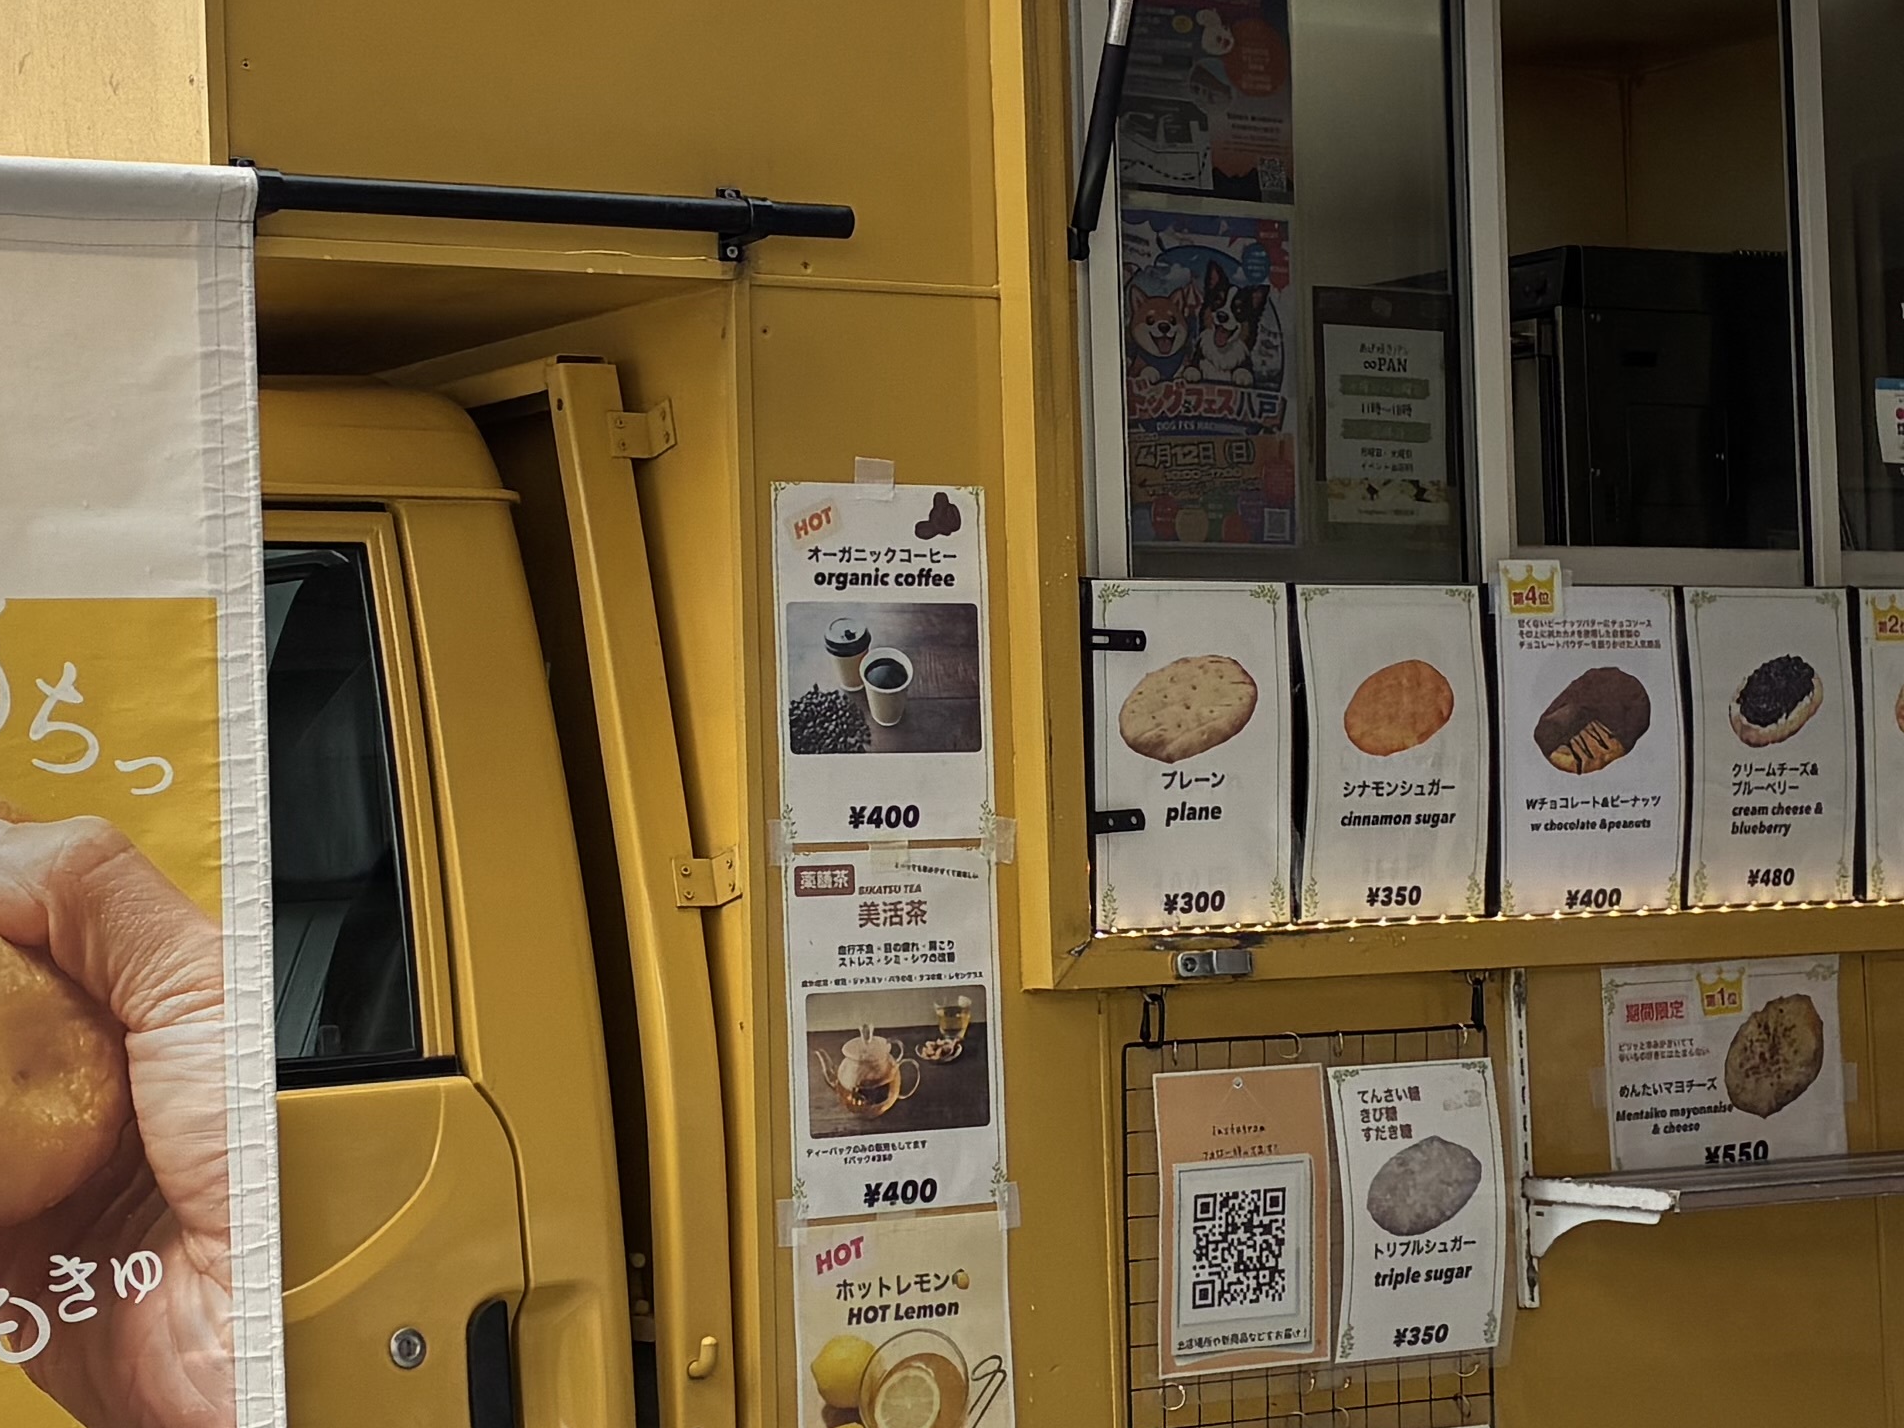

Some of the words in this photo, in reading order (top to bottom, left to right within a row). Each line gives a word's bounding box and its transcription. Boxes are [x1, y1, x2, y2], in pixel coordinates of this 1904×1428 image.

[793, 506, 833, 539] HOT
[807, 546, 957, 564] オーガニックコーヒー
[814, 569, 890, 591] organic
[894, 568, 955, 587] coffee
[1161, 771, 1225, 790] プレーン
[1342, 780, 1455, 799] シナモンシュガー
[1731, 780, 1799, 796] ブルーベリー
[849, 805, 920, 830] ¥400
[1165, 802, 1222, 827] plane
[1340, 811, 1411, 828] cinnamon
[1415, 810, 1456, 829] sugar
[1732, 805, 1769, 816] cream
[1771, 802, 1811, 816] cheese
[1814, 801, 1824, 815] &
[1544, 819, 1596, 831] chocolate
[1731, 821, 1792, 837] blueberry
[904, 883, 922, 893] TEA
[1747, 868, 1795, 887] ¥480
[1164, 890, 1225, 915] ¥300
[1366, 885, 1422, 908] ¥350
[1565, 888, 1622, 909] ¥400
[858, 899, 928, 928] 美活茶
[1625, 999, 1685, 1023] 期間限定
[1358, 1086, 1421, 1103] てんさい糖
[1619, 1077, 1718, 1098] めんたいマヨチーズ
[1360, 1106, 1398, 1123] きび糖
[1616, 1105, 1667, 1122] Mentaiko
[1651, 1123, 1660, 1135] &
[1705, 1139, 1769, 1165] ¥550
[864, 1179, 937, 1208] ¥400
[816, 1236, 864, 1275] HOT
[1373, 1236, 1477, 1260] トリプルシュガー
[836, 1271, 950, 1302] ホットレモン
[1374, 1267, 1421, 1290] triple
[1424, 1263, 1473, 1286] sugar
[848, 1305, 887, 1326] HOT
[894, 1300, 960, 1322] Lemon
[1393, 1324, 1448, 1347] ¥350
